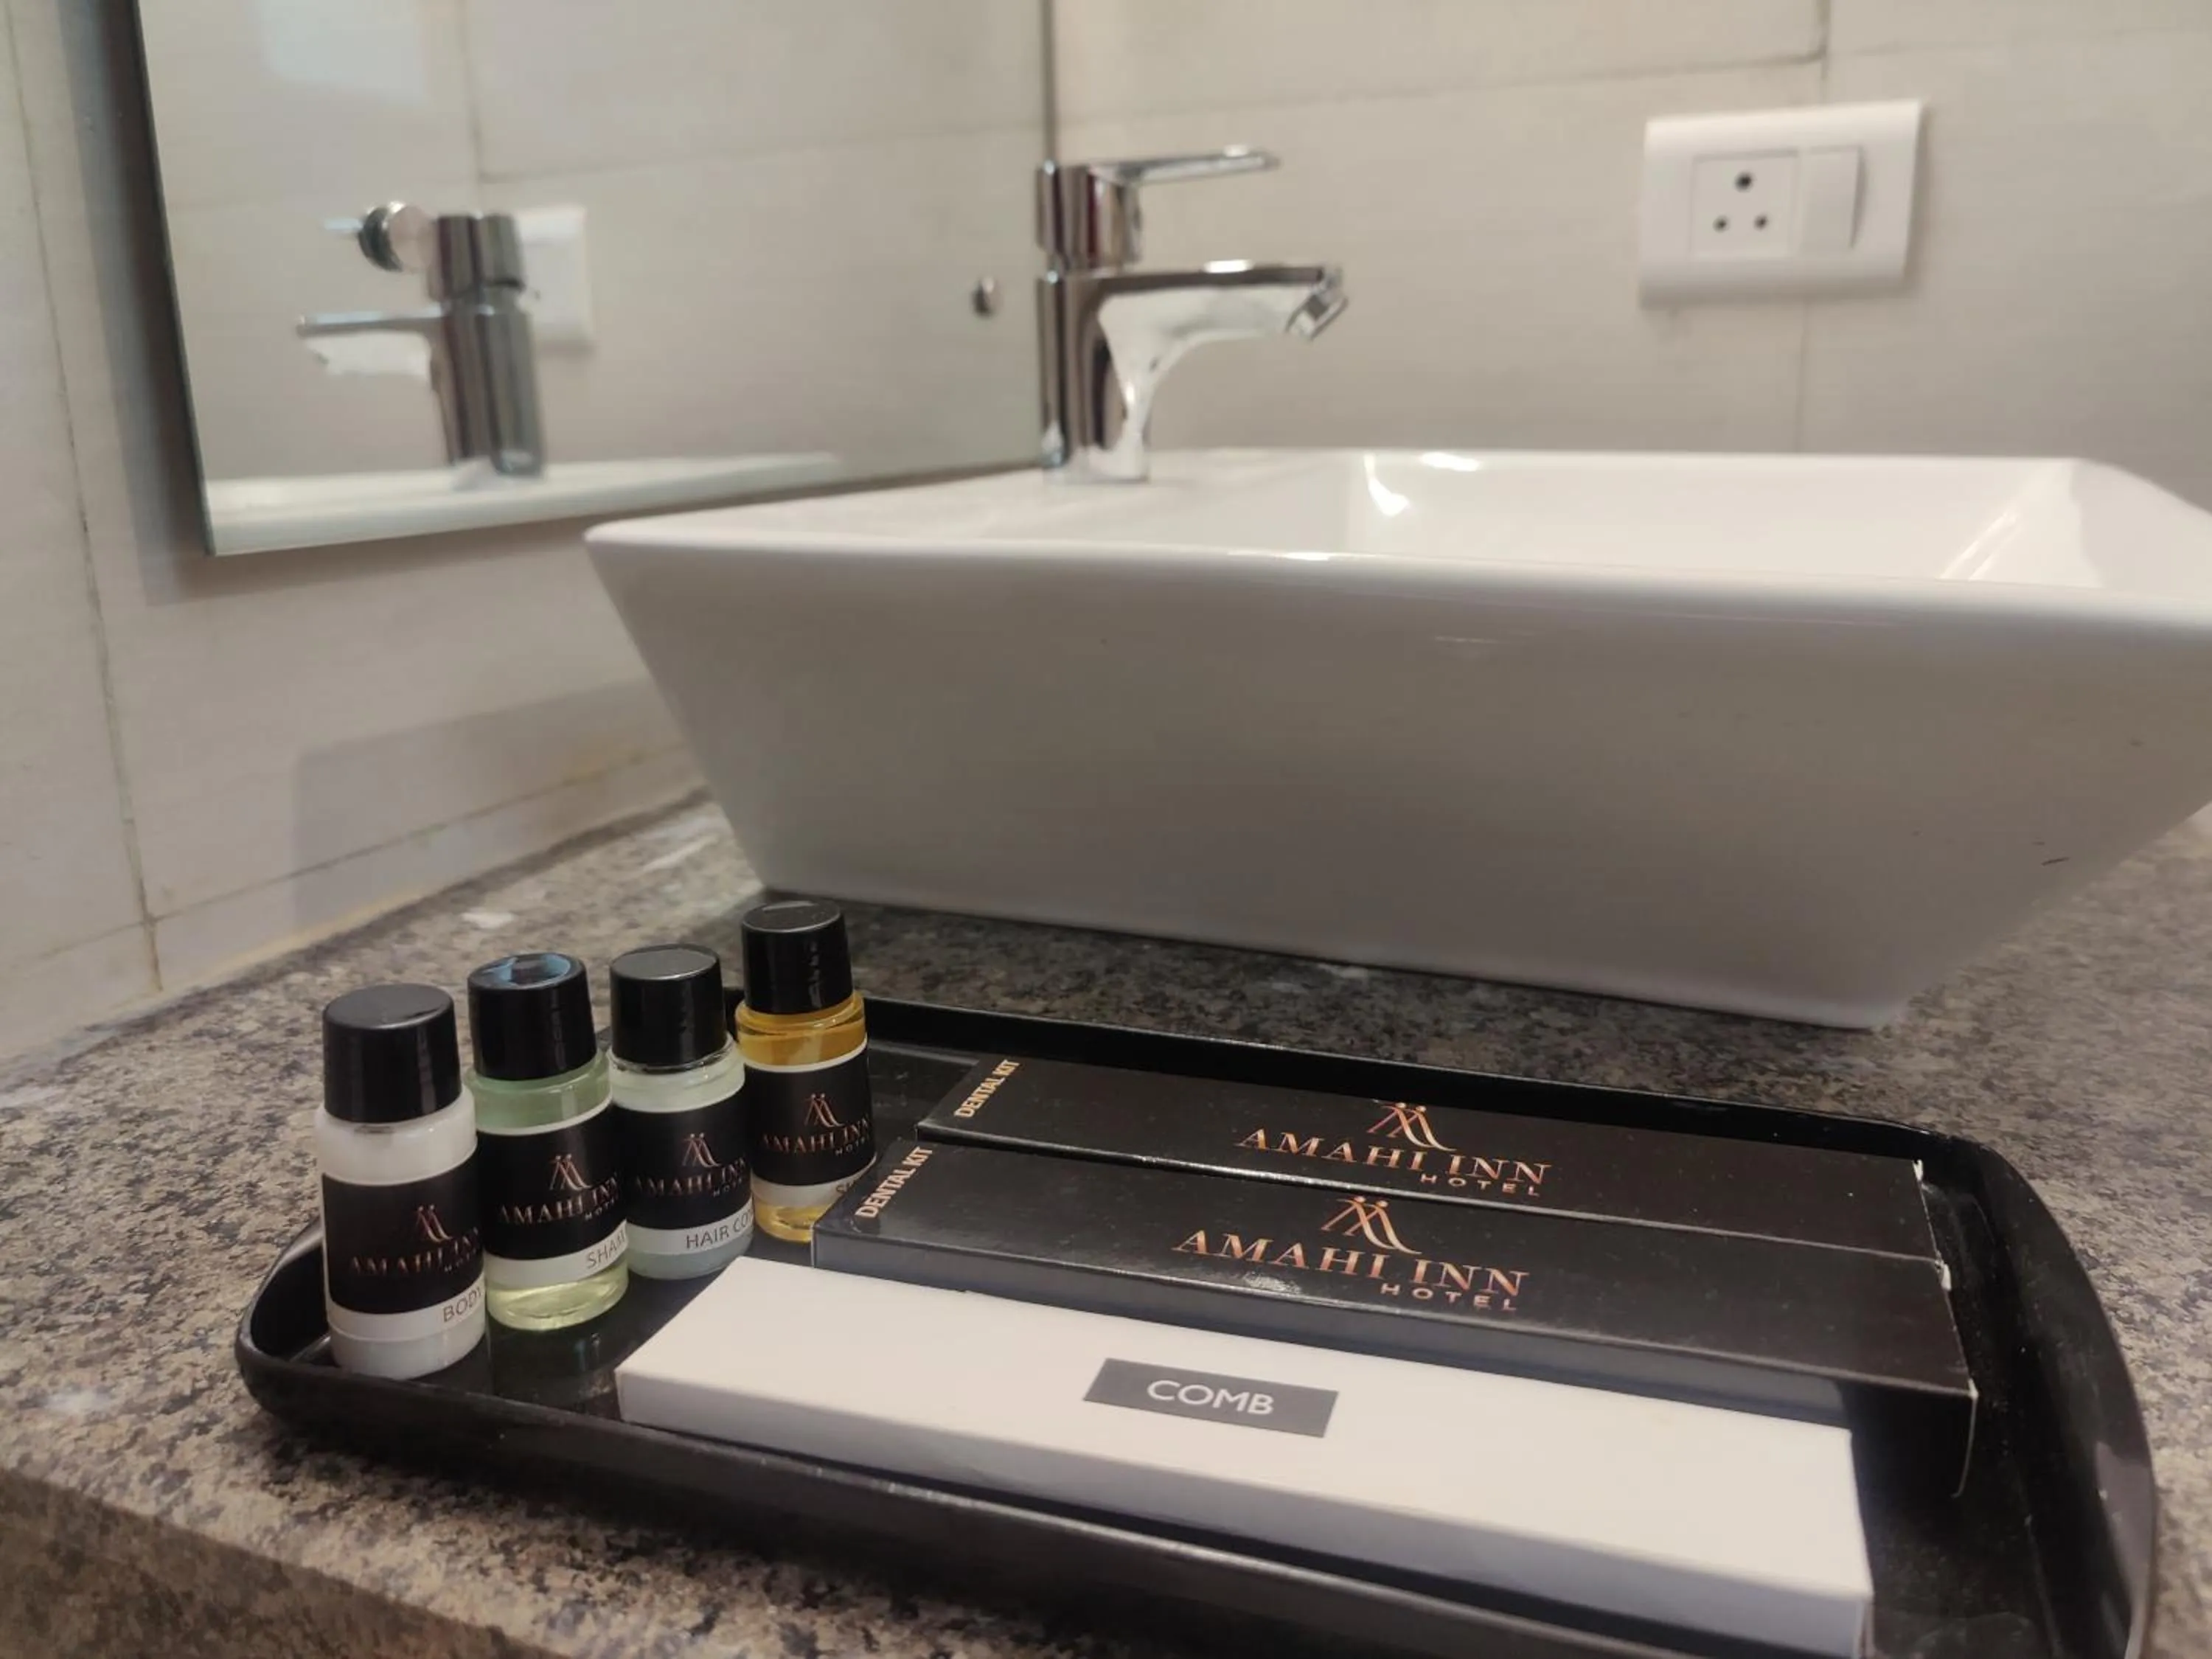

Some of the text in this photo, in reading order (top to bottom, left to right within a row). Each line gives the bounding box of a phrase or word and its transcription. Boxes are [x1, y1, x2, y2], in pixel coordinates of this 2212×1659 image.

[953, 1058, 1020, 1118] DENTAL KIT
[1234, 1127, 1552, 1185] AMAHI INN
[854, 1145, 933, 1218] DENTAL KIT
[1419, 1173, 1540, 1197] HOTEL
[686, 1223, 730, 1249] HAIR
[1172, 1229, 1530, 1297] AMAHI INN
[1380, 1282, 1517, 1312] HOTEL
[1147, 1379, 1274, 1416] COMB
